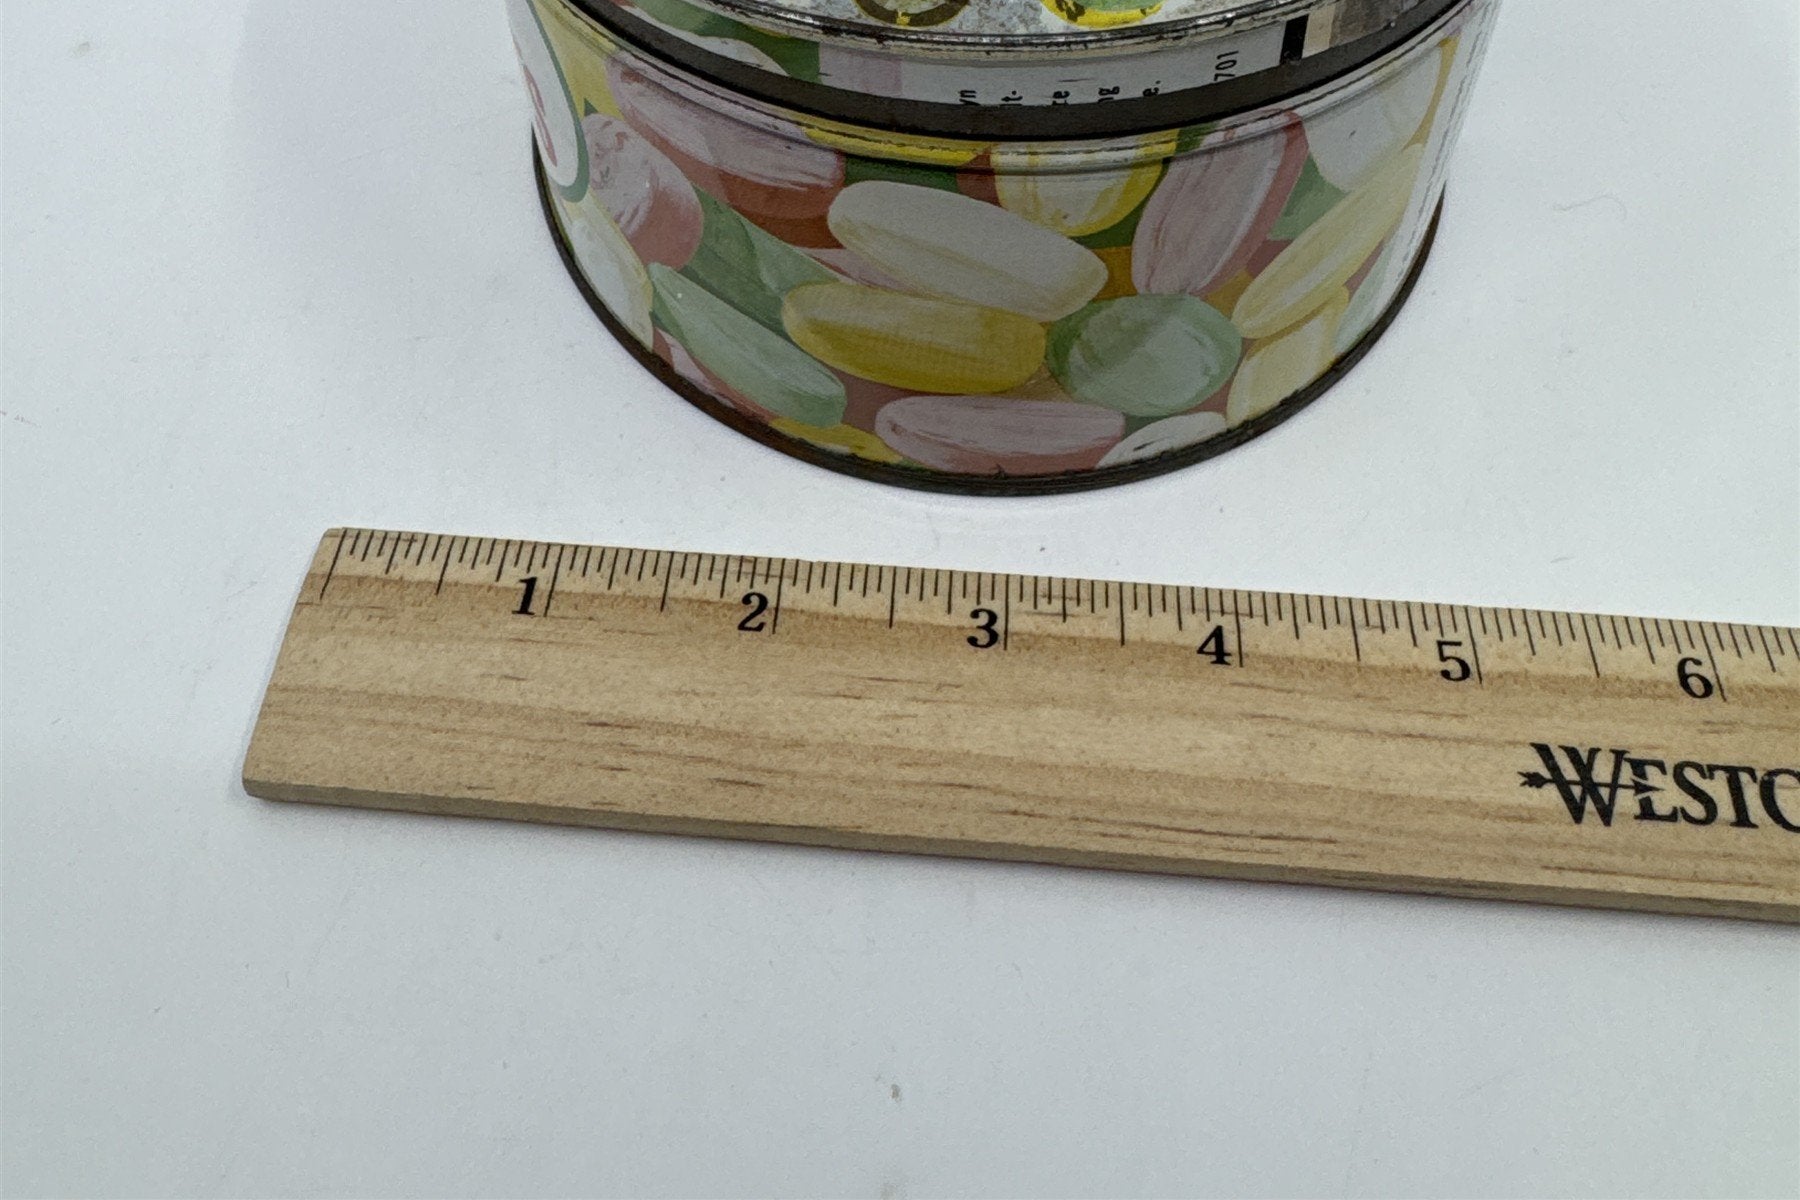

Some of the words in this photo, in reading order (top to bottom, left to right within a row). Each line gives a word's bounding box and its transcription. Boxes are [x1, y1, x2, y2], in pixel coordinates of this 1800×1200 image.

[511, 576, 539, 617] 1
[737, 591, 770, 633] 2
[966, 607, 1000, 649] 3
[1196, 624, 1232, 667] 4
[1436, 639, 1472, 682] 5
[1676, 656, 1714, 699] 6
